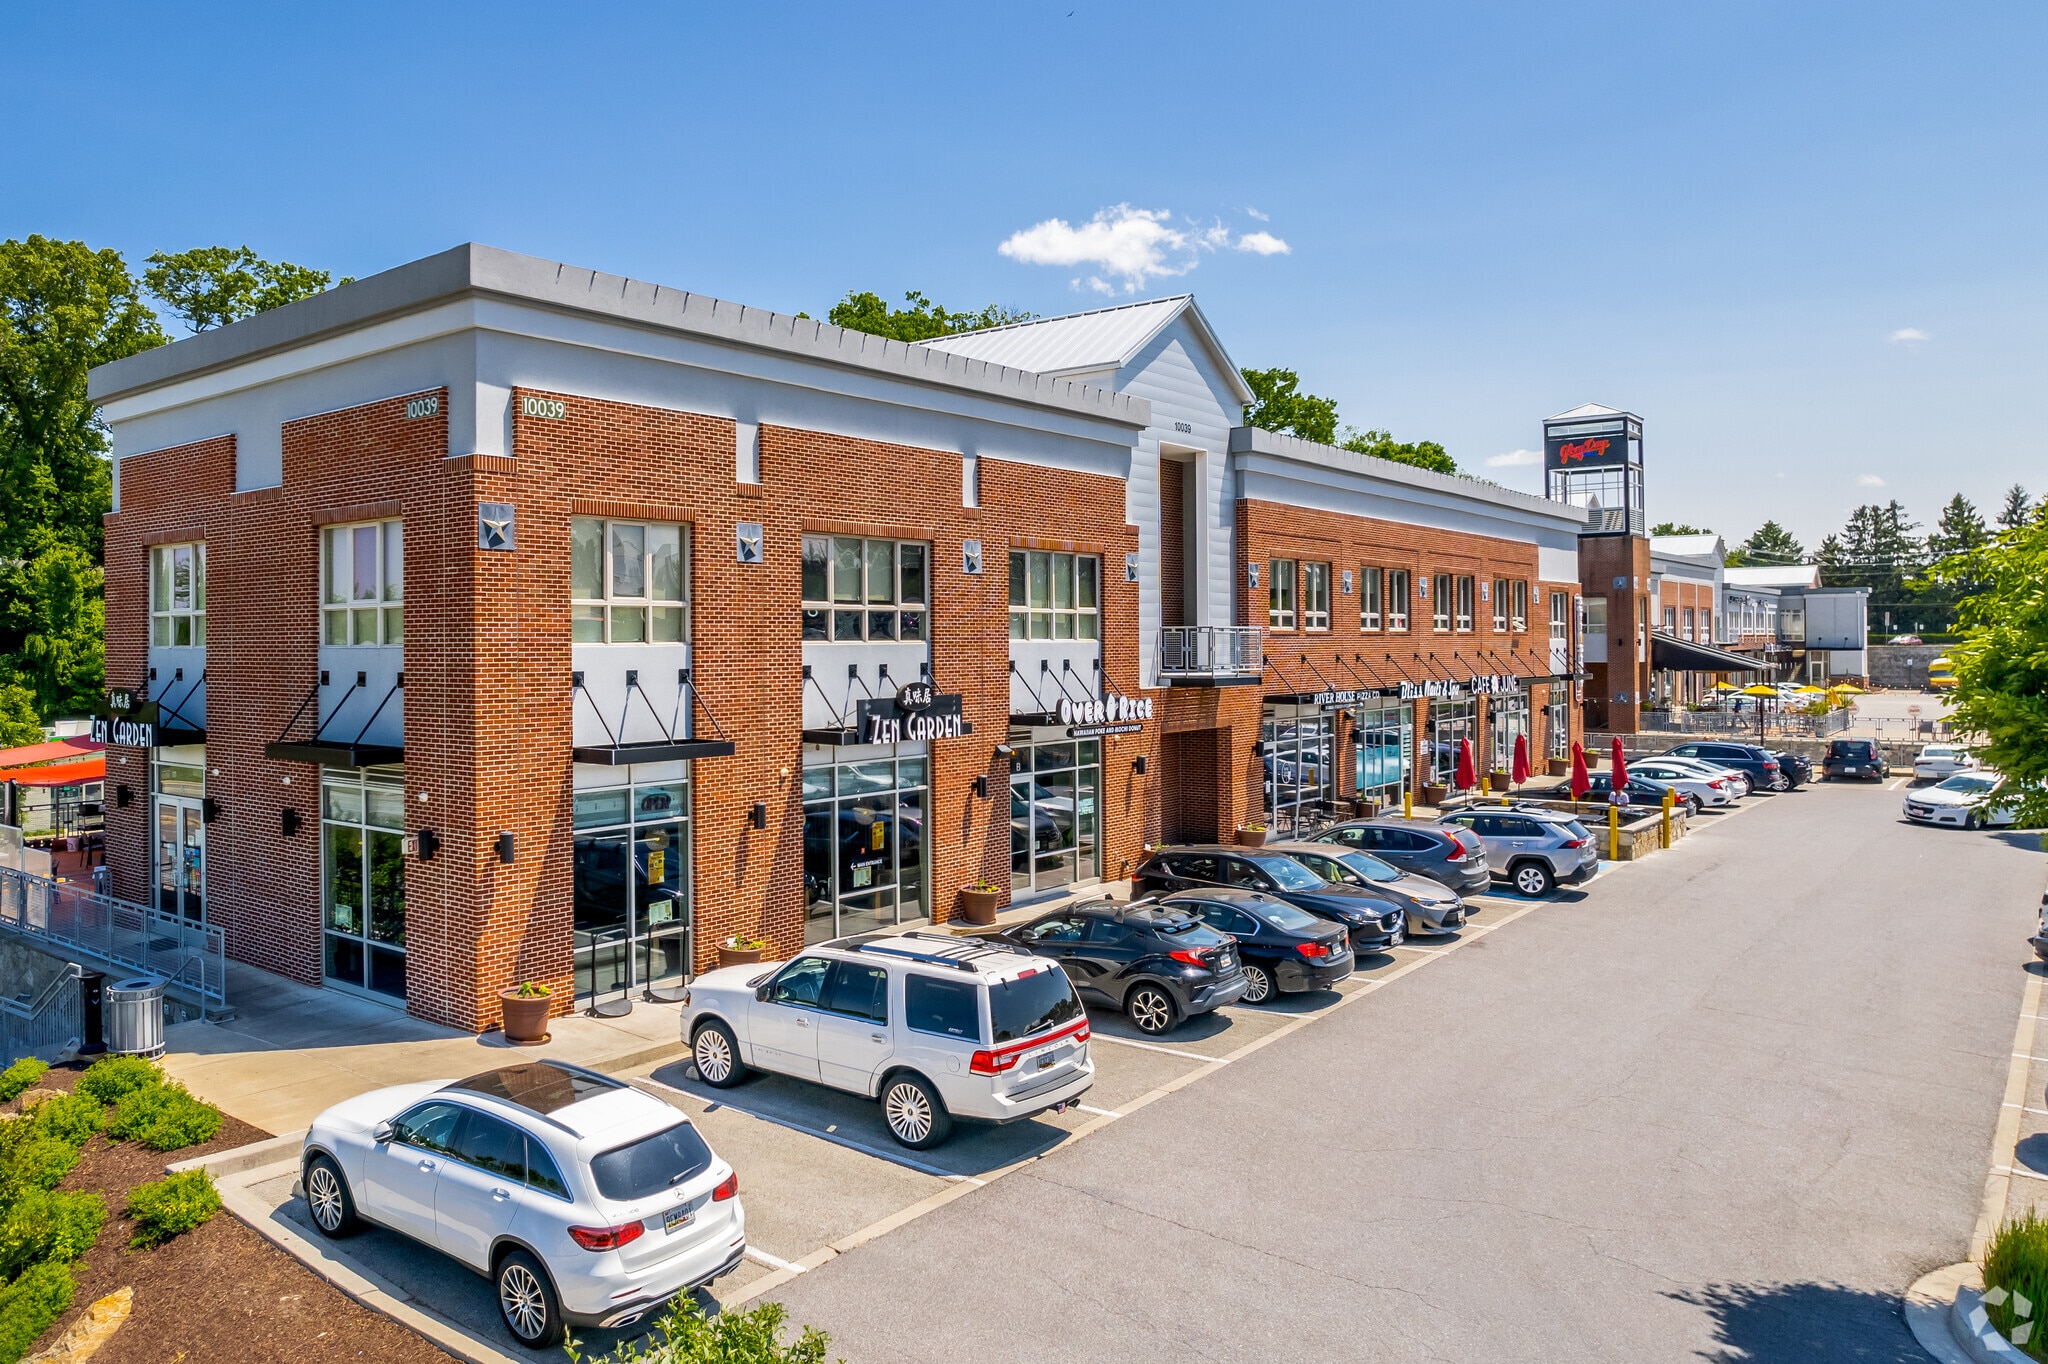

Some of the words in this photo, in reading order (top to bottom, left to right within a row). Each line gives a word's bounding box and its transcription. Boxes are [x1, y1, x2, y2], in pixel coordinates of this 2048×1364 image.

[407, 397, 438, 418] 10039
[523, 397, 565, 418] 10039
[1174, 421, 1192, 434] 10039
[1472, 676, 1491, 694] CAFE
[1500, 675, 1517, 692] JUNE
[1314, 692, 1335, 704] RIVER
[1335, 691, 1356, 703] HOUSE
[1356, 692, 1372, 700] PIZZA
[1060, 699, 1105, 725] OVER
[1119, 695, 1153, 720] RICE
[90, 714, 108, 744] ZEN
[113, 716, 153, 748] GARDEN
[872, 714, 900, 745] ZEN
[907, 711, 961, 741] GARDEN
[1106, 726, 1114, 734] AND
[641, 794, 671, 811] OPEN
